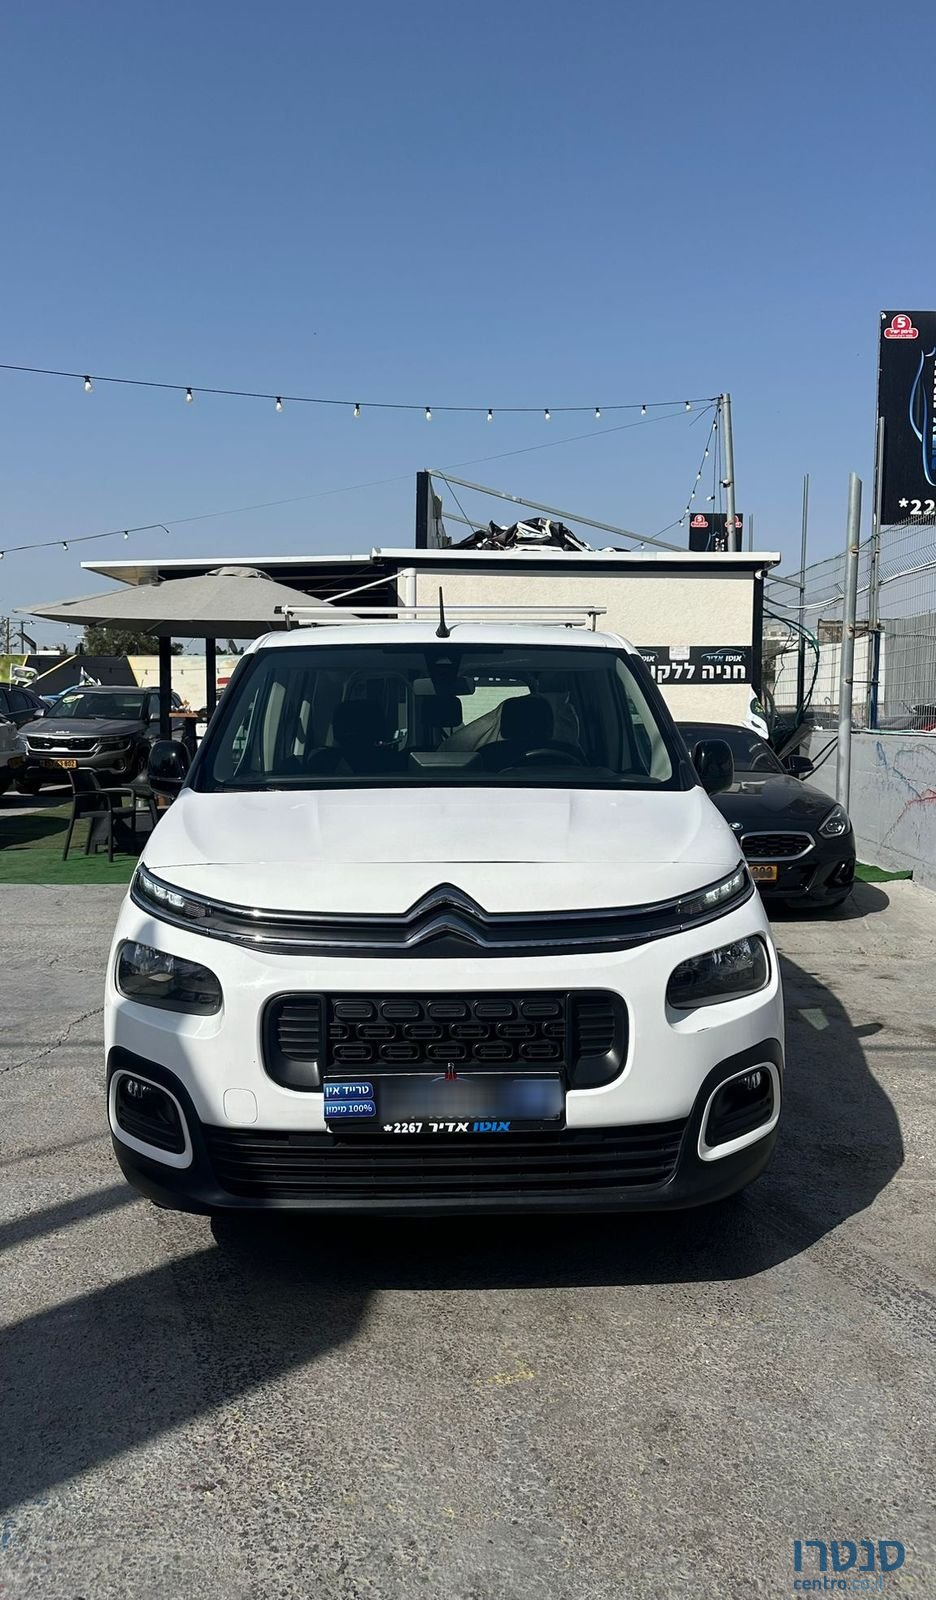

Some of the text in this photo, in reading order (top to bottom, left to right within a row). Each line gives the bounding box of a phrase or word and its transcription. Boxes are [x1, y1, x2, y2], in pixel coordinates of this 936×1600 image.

[897, 317, 906, 328] 5
[702, 665, 746, 679] חניה
[326, 1086, 369, 1097] טרייד אין
[326, 1104, 373, 1114] 100% מימון
[428, 1122, 469, 1132] אדיר
[473, 1121, 511, 1132] אוטו
